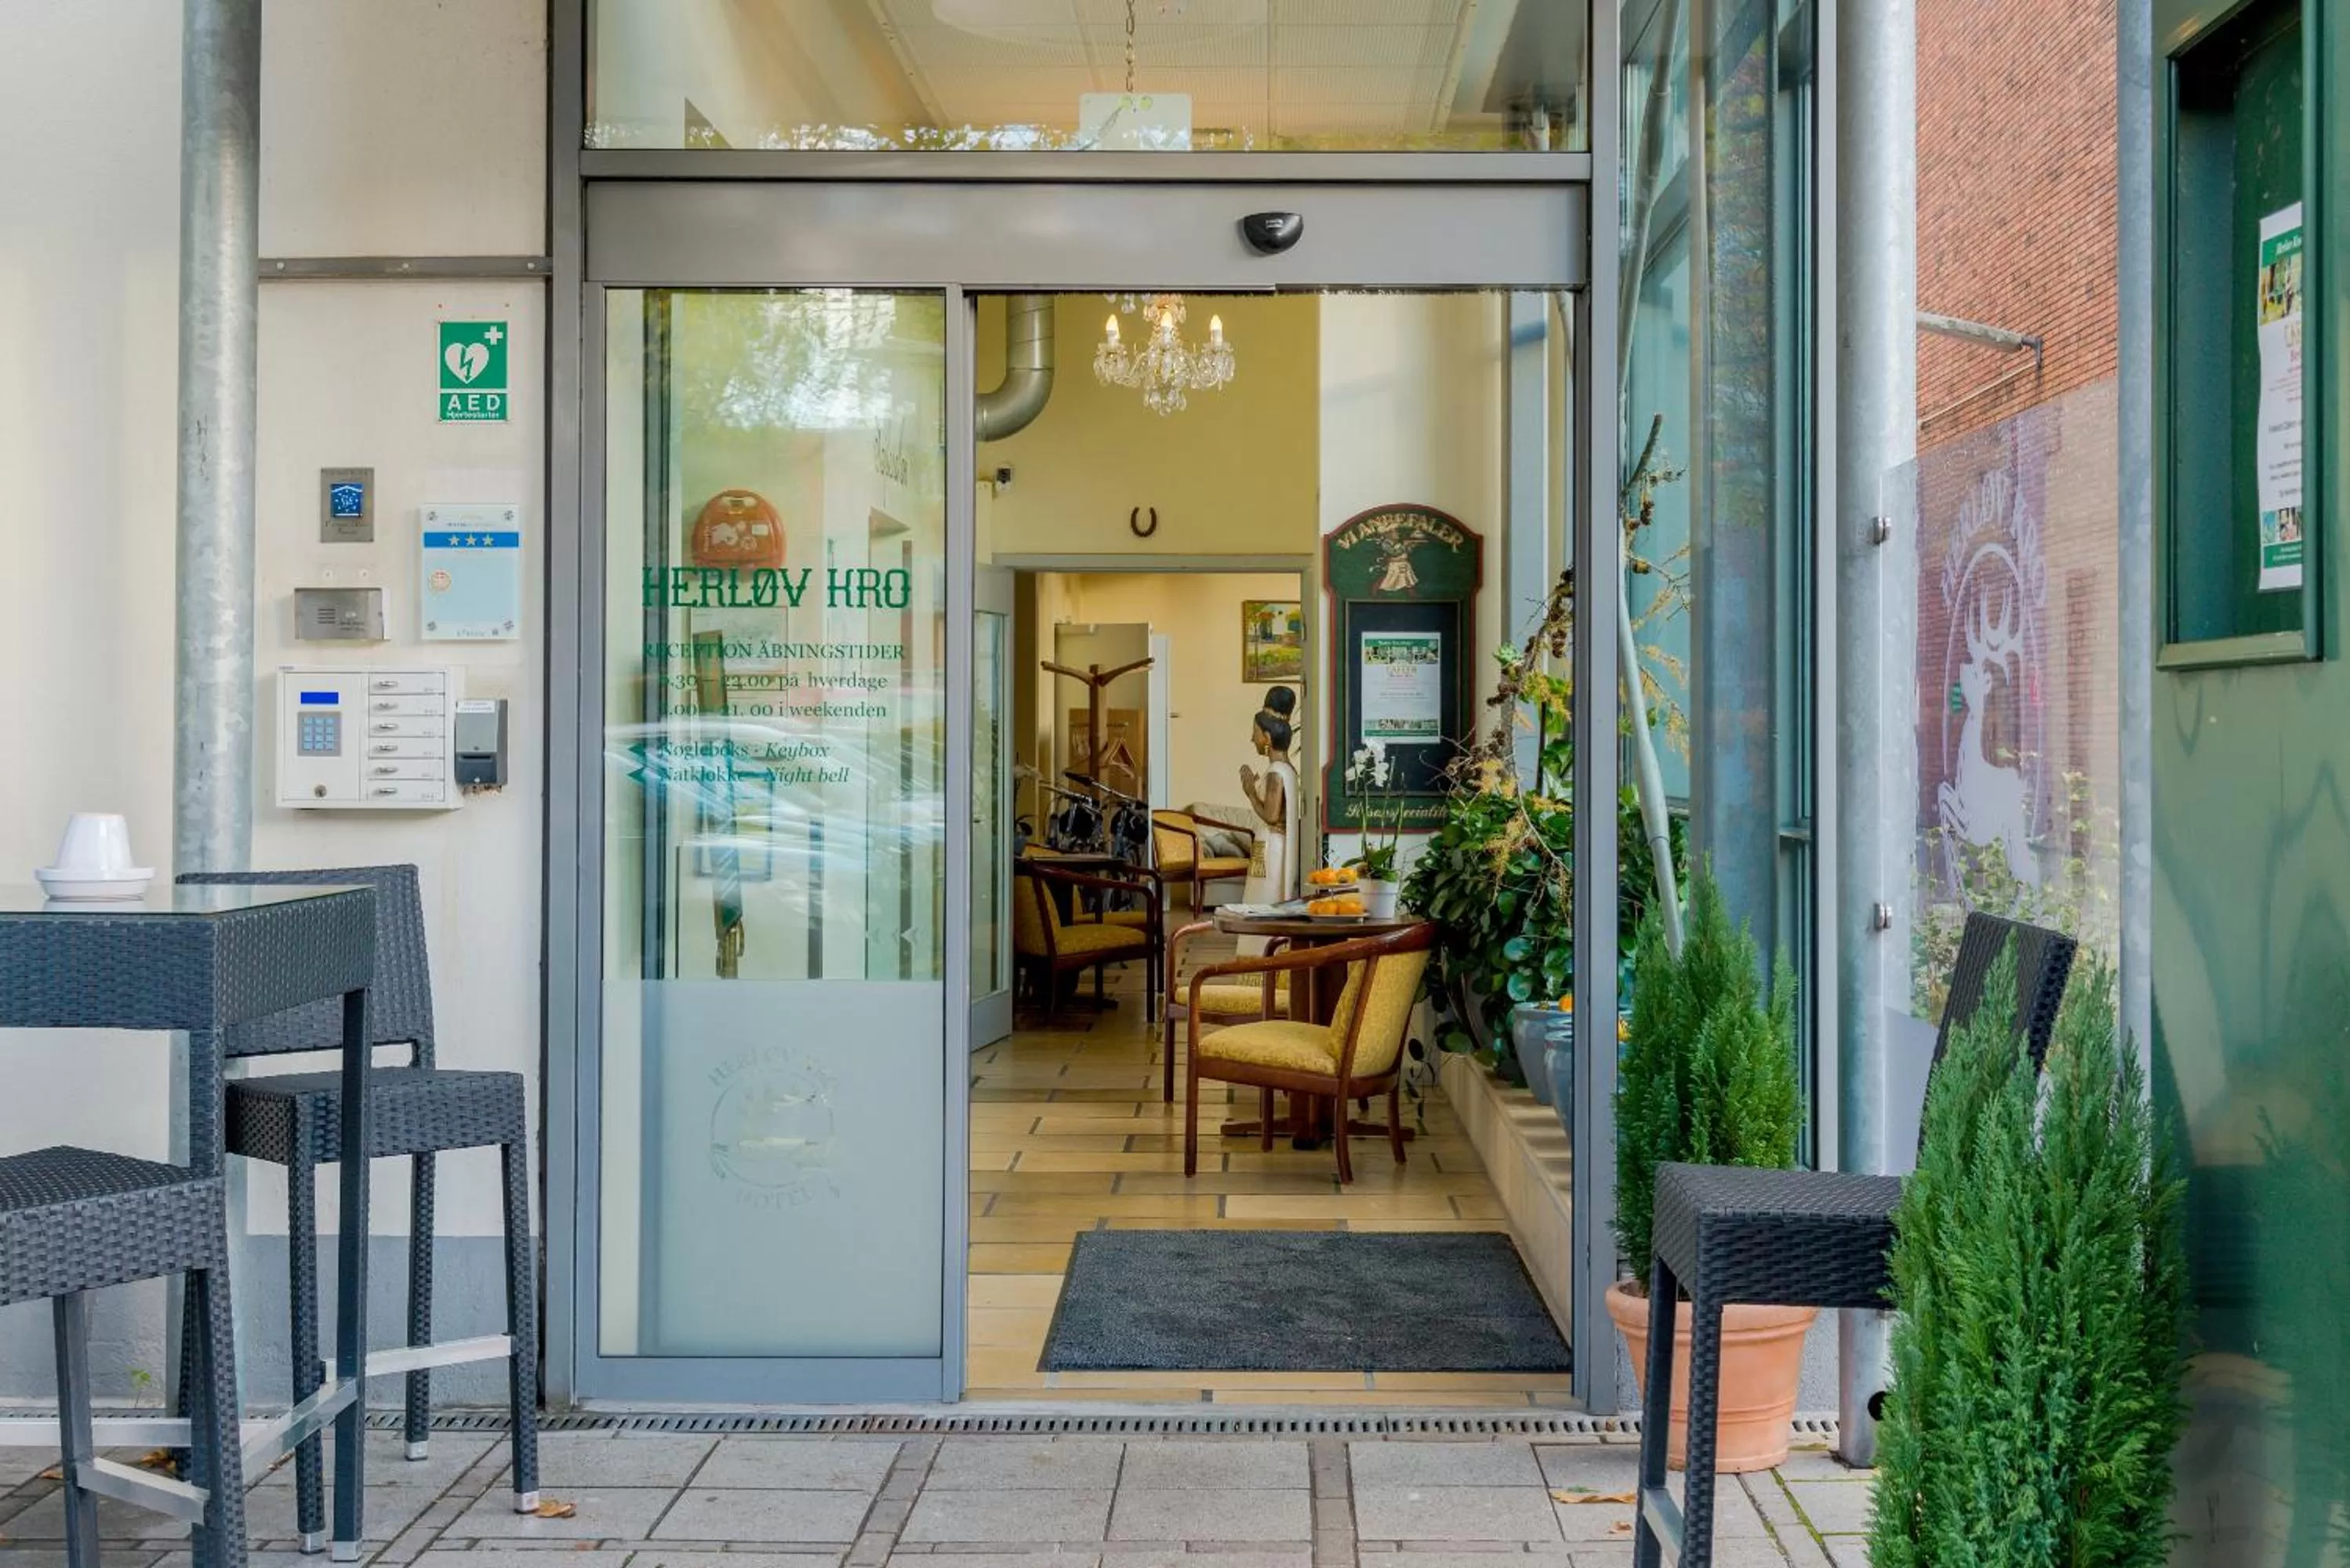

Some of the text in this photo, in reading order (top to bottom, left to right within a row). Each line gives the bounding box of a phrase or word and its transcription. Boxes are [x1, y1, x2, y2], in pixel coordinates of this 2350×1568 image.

[447, 394, 500, 411] AED
[642, 567, 812, 608] HERLØV
[645, 638, 905, 660] RECEPTION ÅBNINGSTIDER
[808, 671, 888, 691] hverdage
[780, 701, 786, 717] i
[790, 701, 887, 718] weekenden
[765, 742, 830, 761] Keybox
[763, 766, 813, 786] Night
[818, 766, 850, 783] bell
